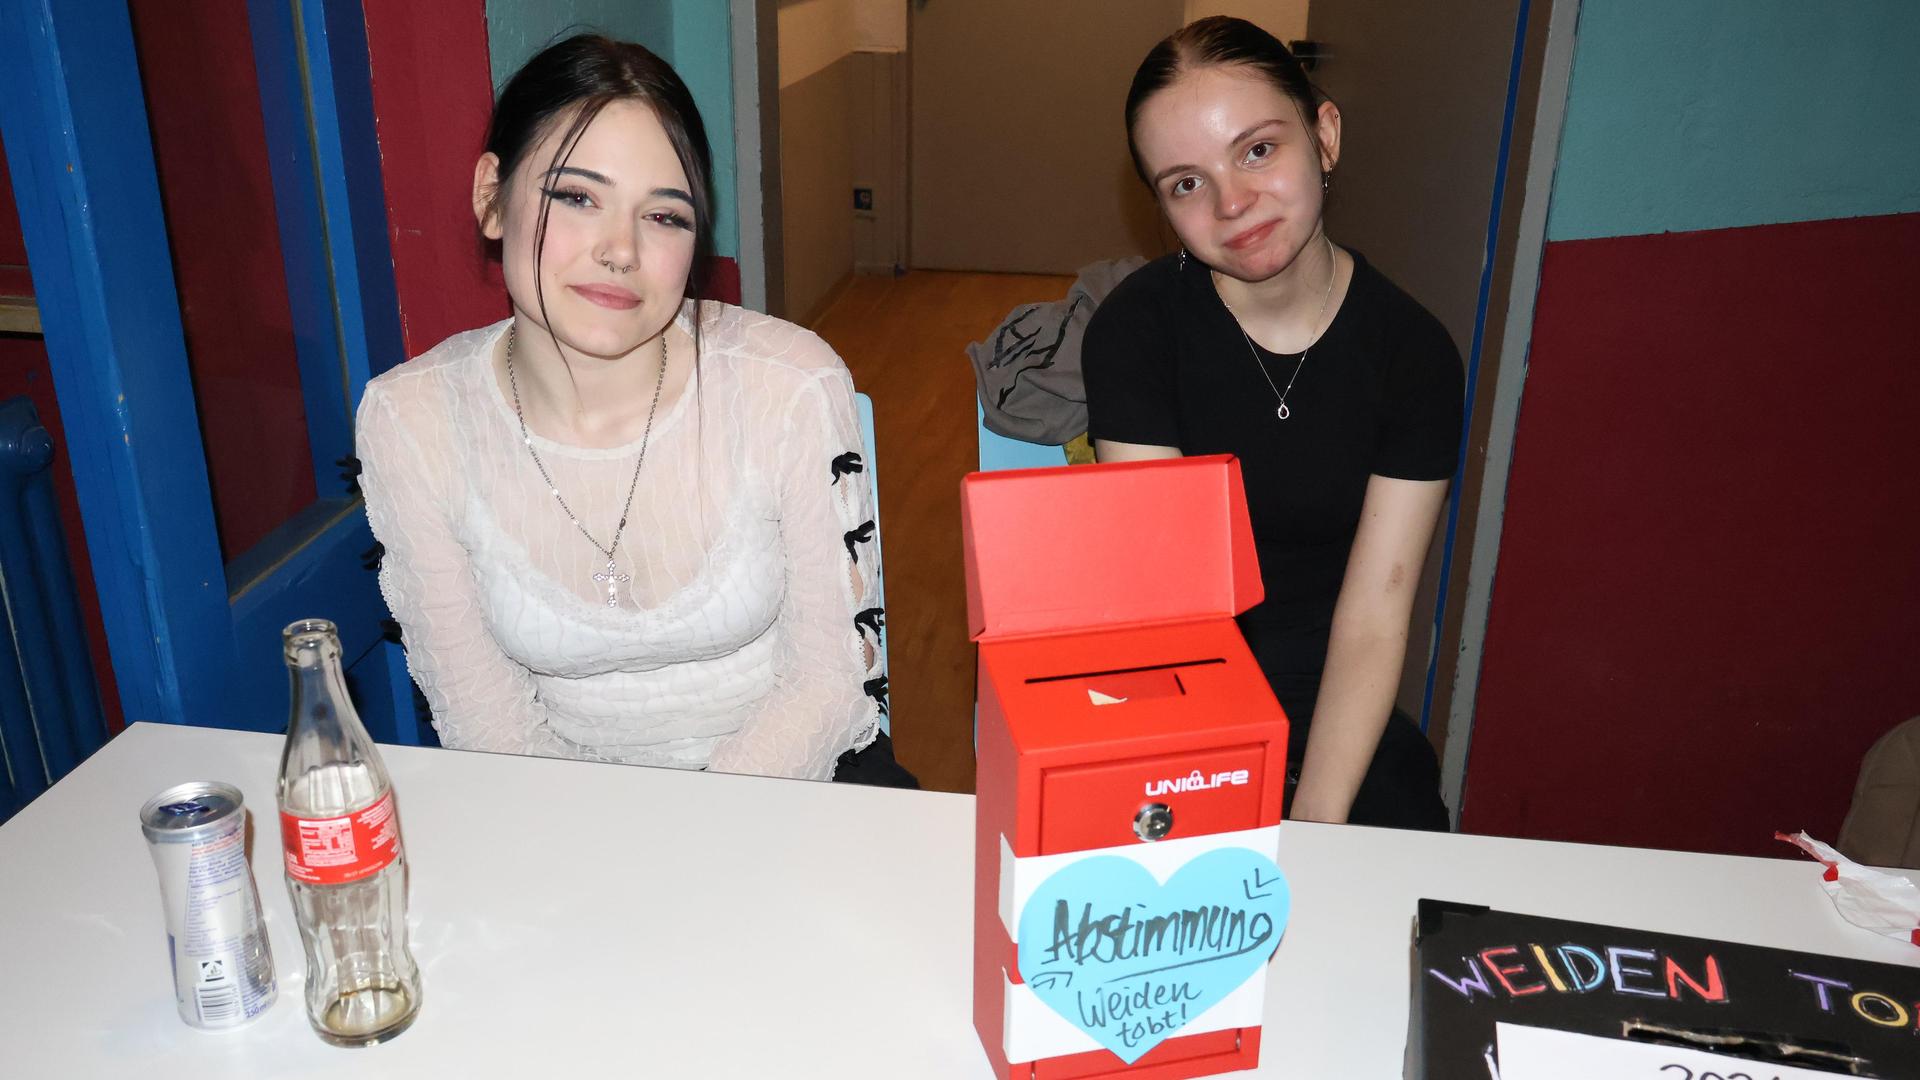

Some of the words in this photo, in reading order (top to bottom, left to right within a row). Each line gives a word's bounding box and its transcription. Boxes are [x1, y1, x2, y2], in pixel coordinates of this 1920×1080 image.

[1077, 981, 1202, 1028] Weiden
[1429, 943, 1729, 1003] WEIDEN
[1789, 969, 1920, 1036] TO
[1116, 1003, 1186, 1048] tobt!
